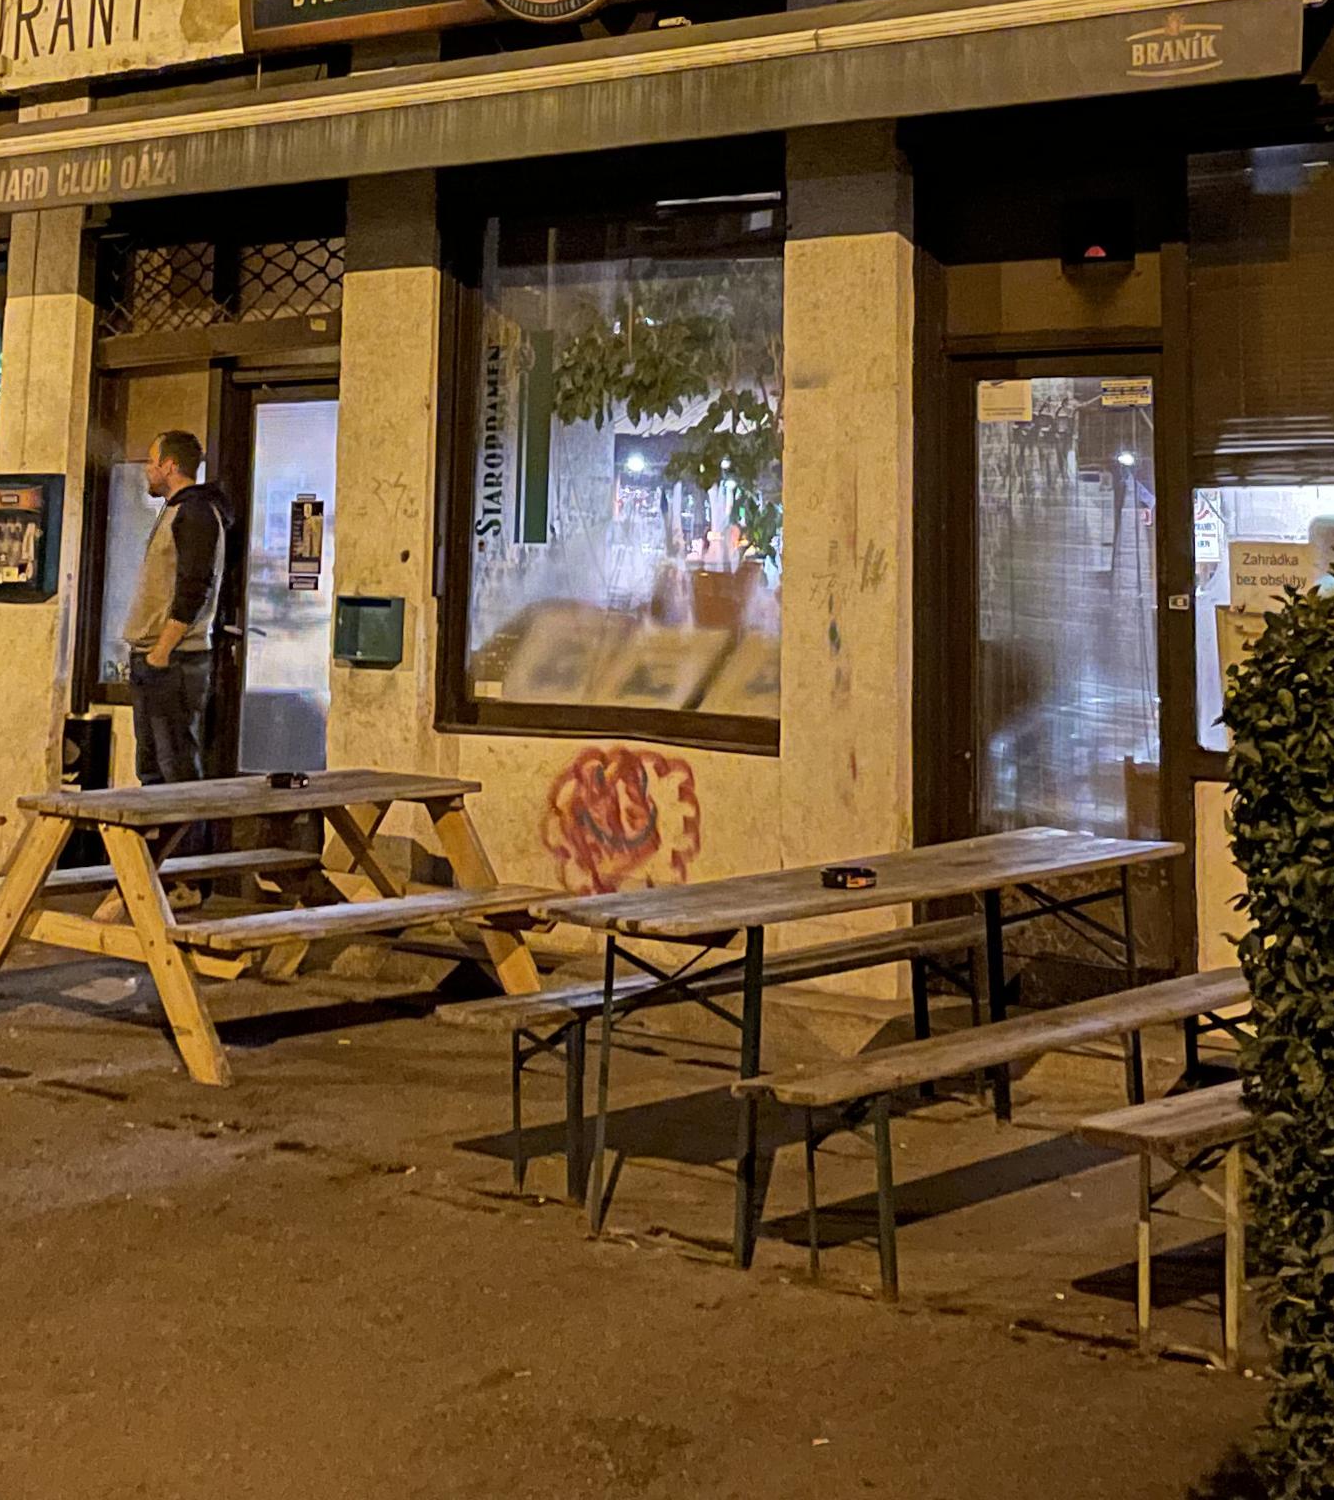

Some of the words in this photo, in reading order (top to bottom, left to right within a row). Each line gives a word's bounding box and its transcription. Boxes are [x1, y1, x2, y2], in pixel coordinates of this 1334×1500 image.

[1131, 31, 1217, 67] BRANÍK
[57, 157, 112, 197] CLUB
[120, 143, 177, 190] OÁZA
[1242, 551, 1299, 566] Zahrádka
[1236, 574, 1257, 586] bez
